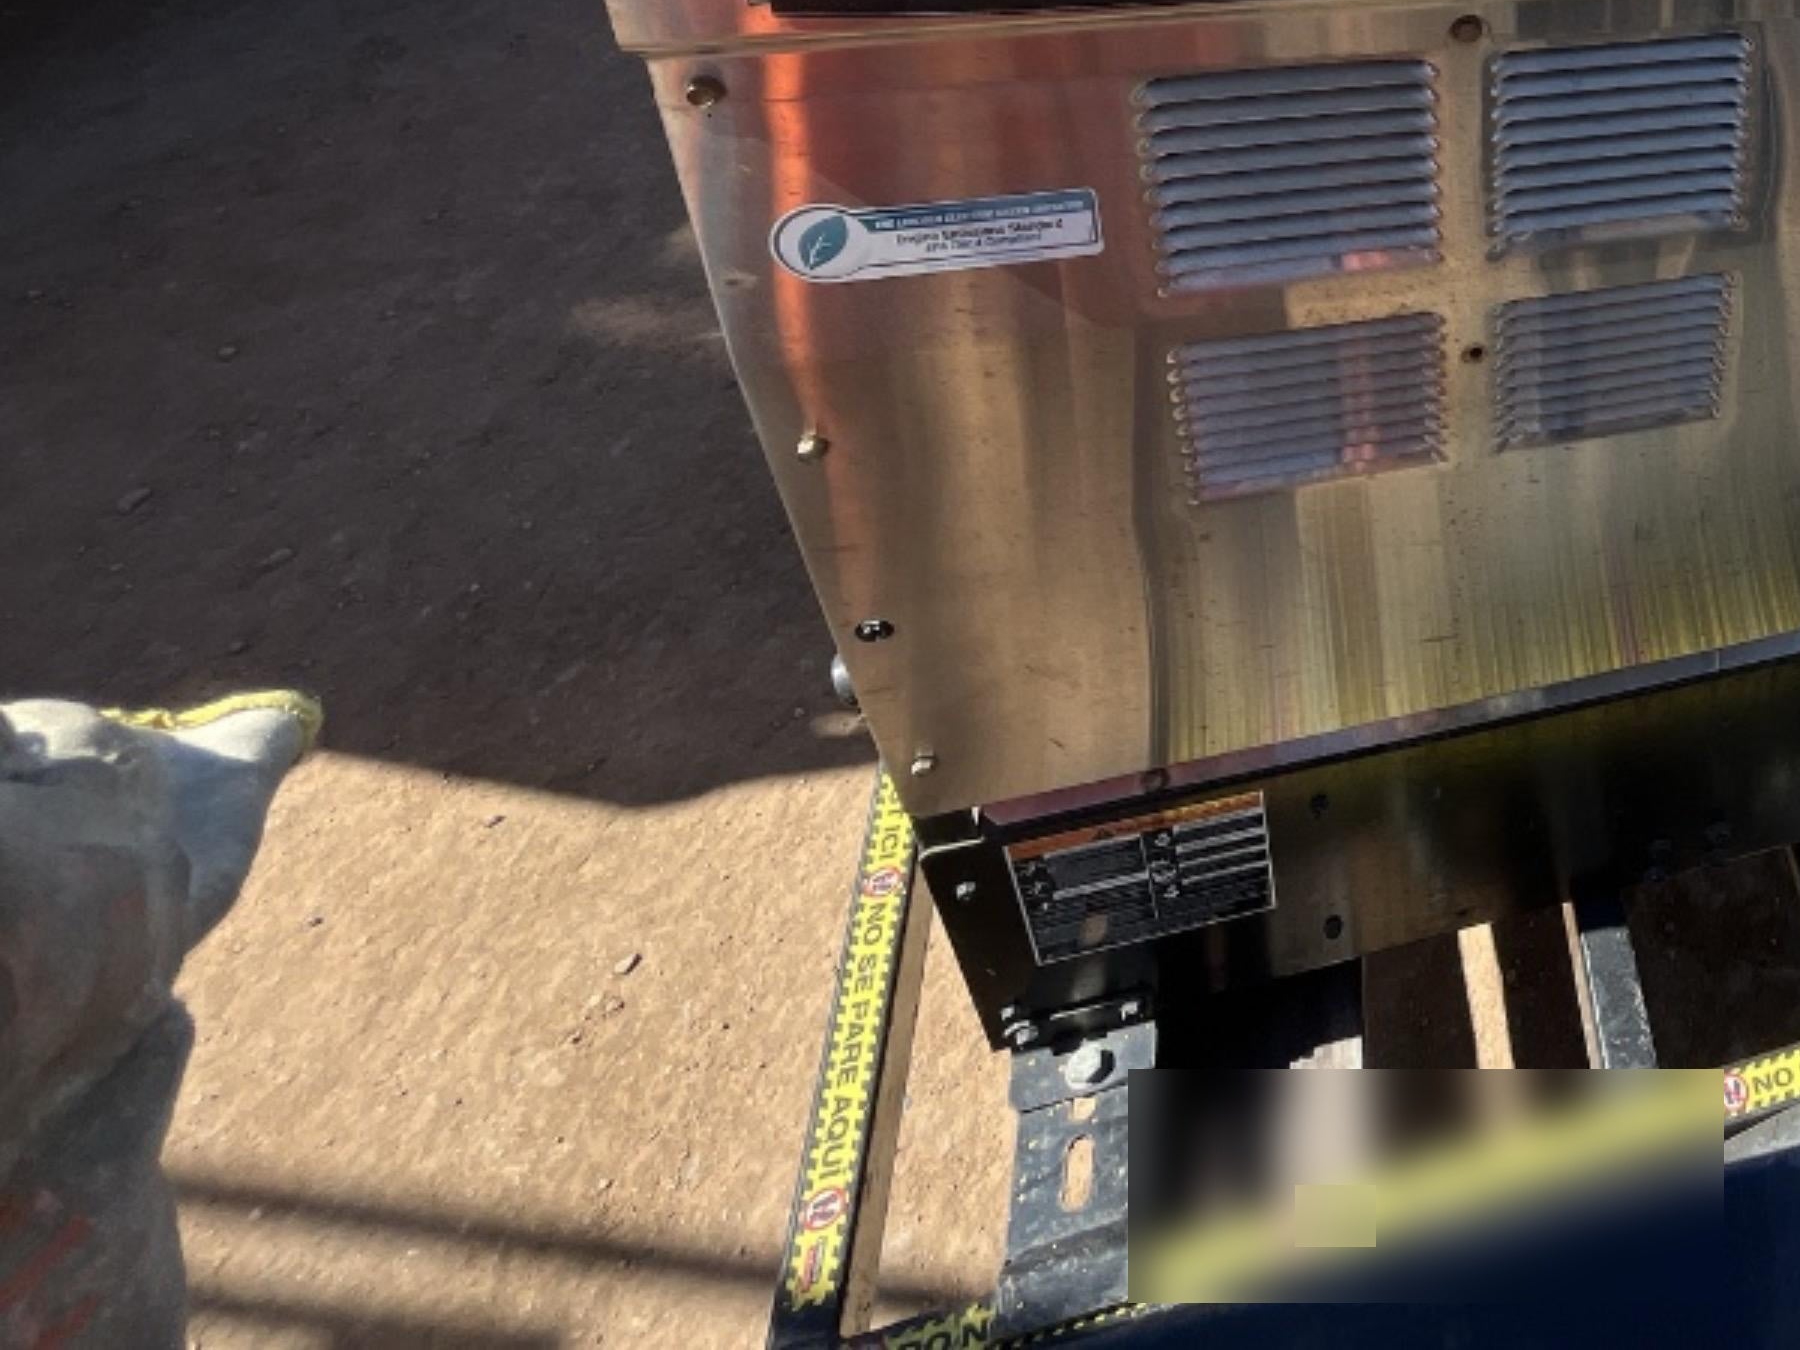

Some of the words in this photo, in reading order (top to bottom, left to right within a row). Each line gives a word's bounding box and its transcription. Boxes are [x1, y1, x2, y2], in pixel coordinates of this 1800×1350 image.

[863, 902, 887, 947] NO
[854, 953, 878, 994] SE
[836, 998, 872, 1088] PARE
[1752, 1066, 1795, 1095] NO
